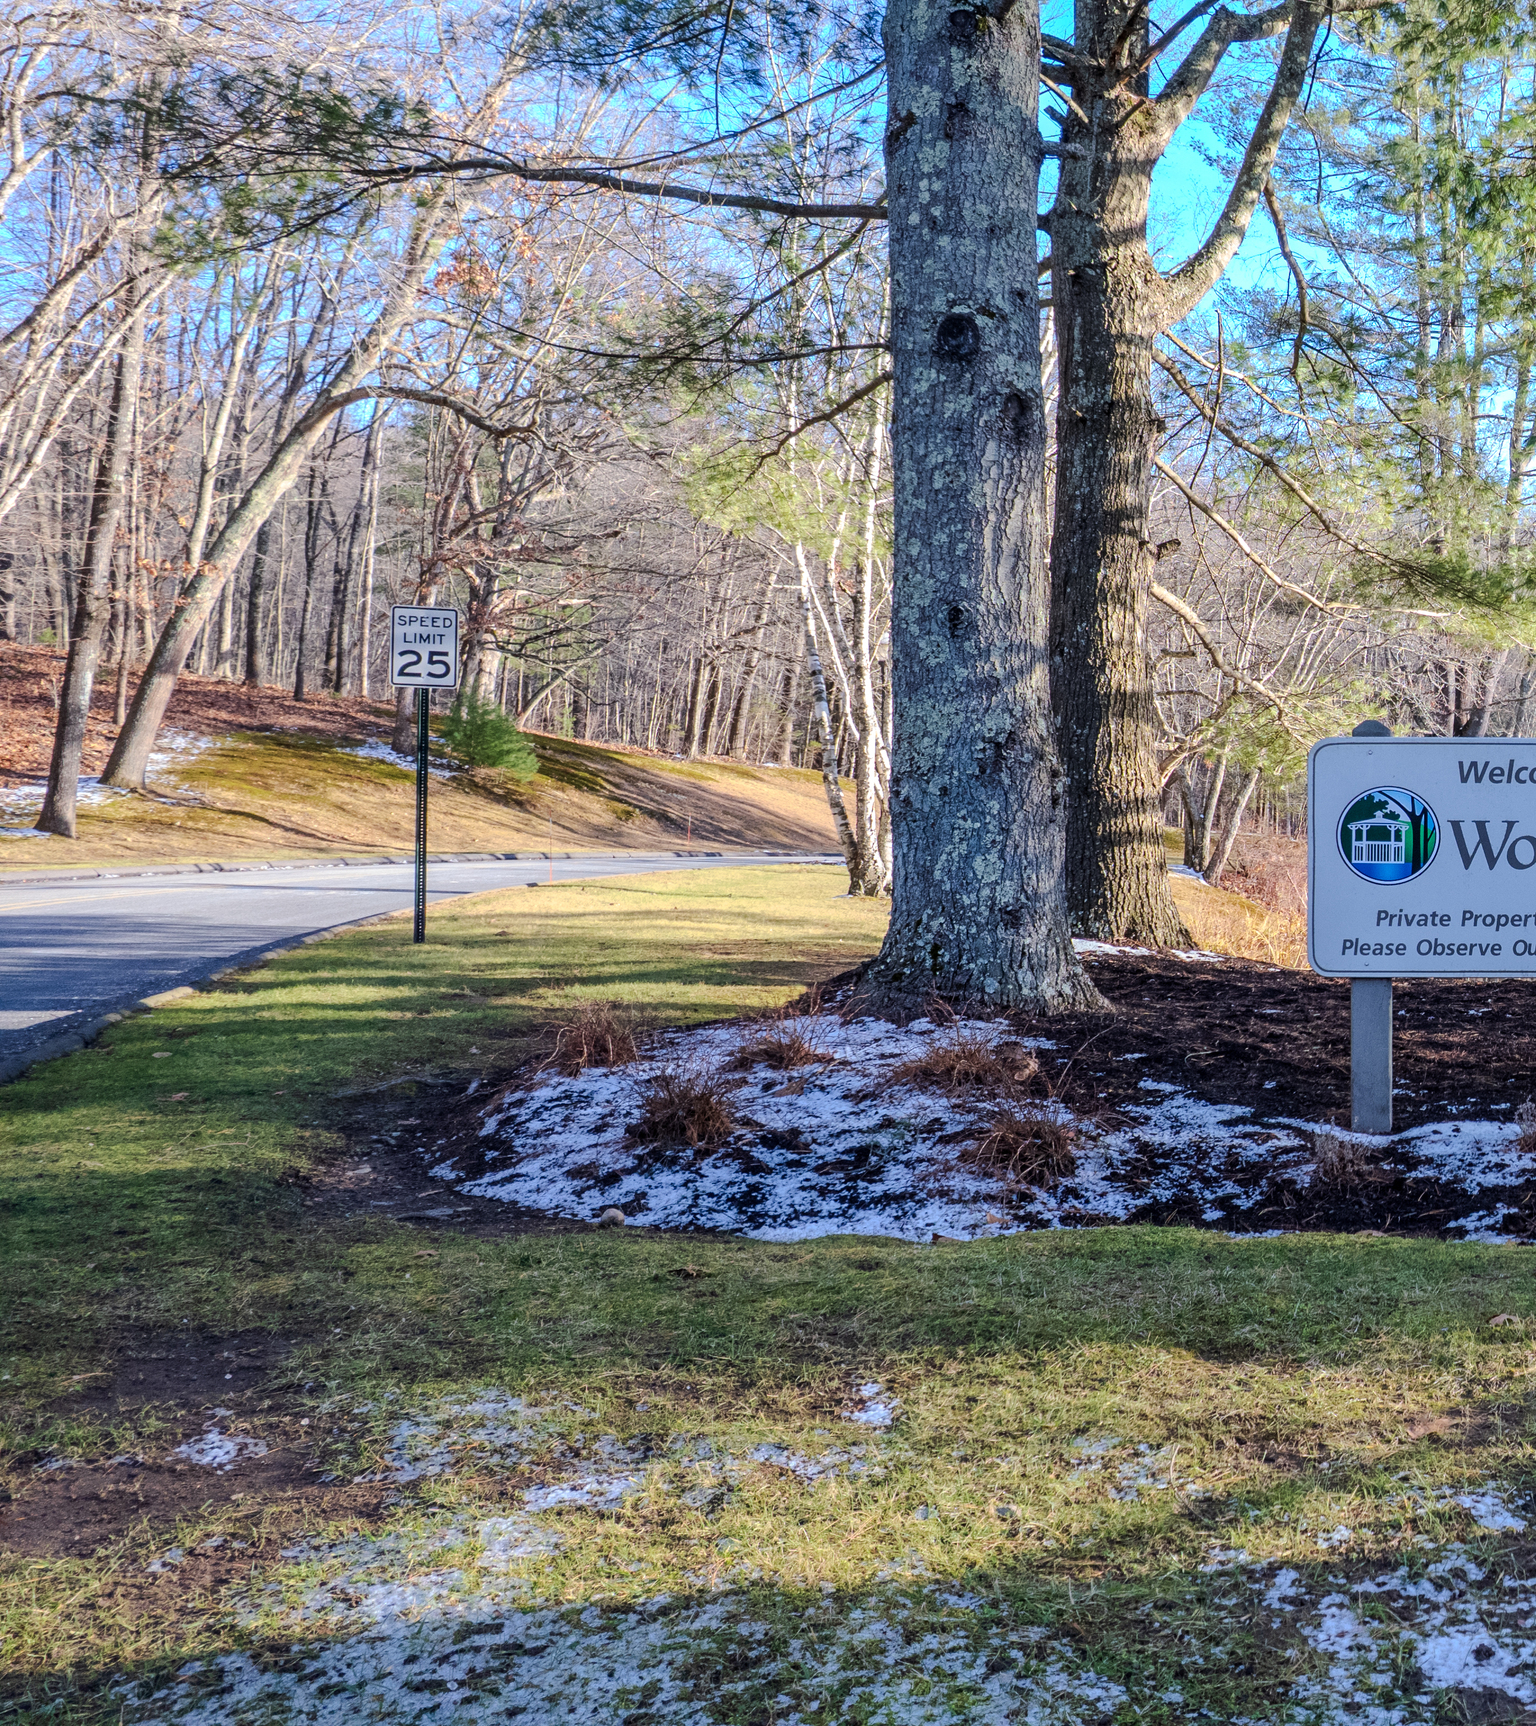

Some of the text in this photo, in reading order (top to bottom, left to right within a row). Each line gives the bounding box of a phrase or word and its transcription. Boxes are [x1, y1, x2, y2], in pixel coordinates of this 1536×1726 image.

[397, 615, 453, 628] SPEED
[403, 632, 446, 645] LIMIT
[397, 649, 451, 679] 25
[1376, 908, 1452, 928] Private
[1341, 937, 1407, 957] Please
[1415, 937, 1503, 957] Observe
